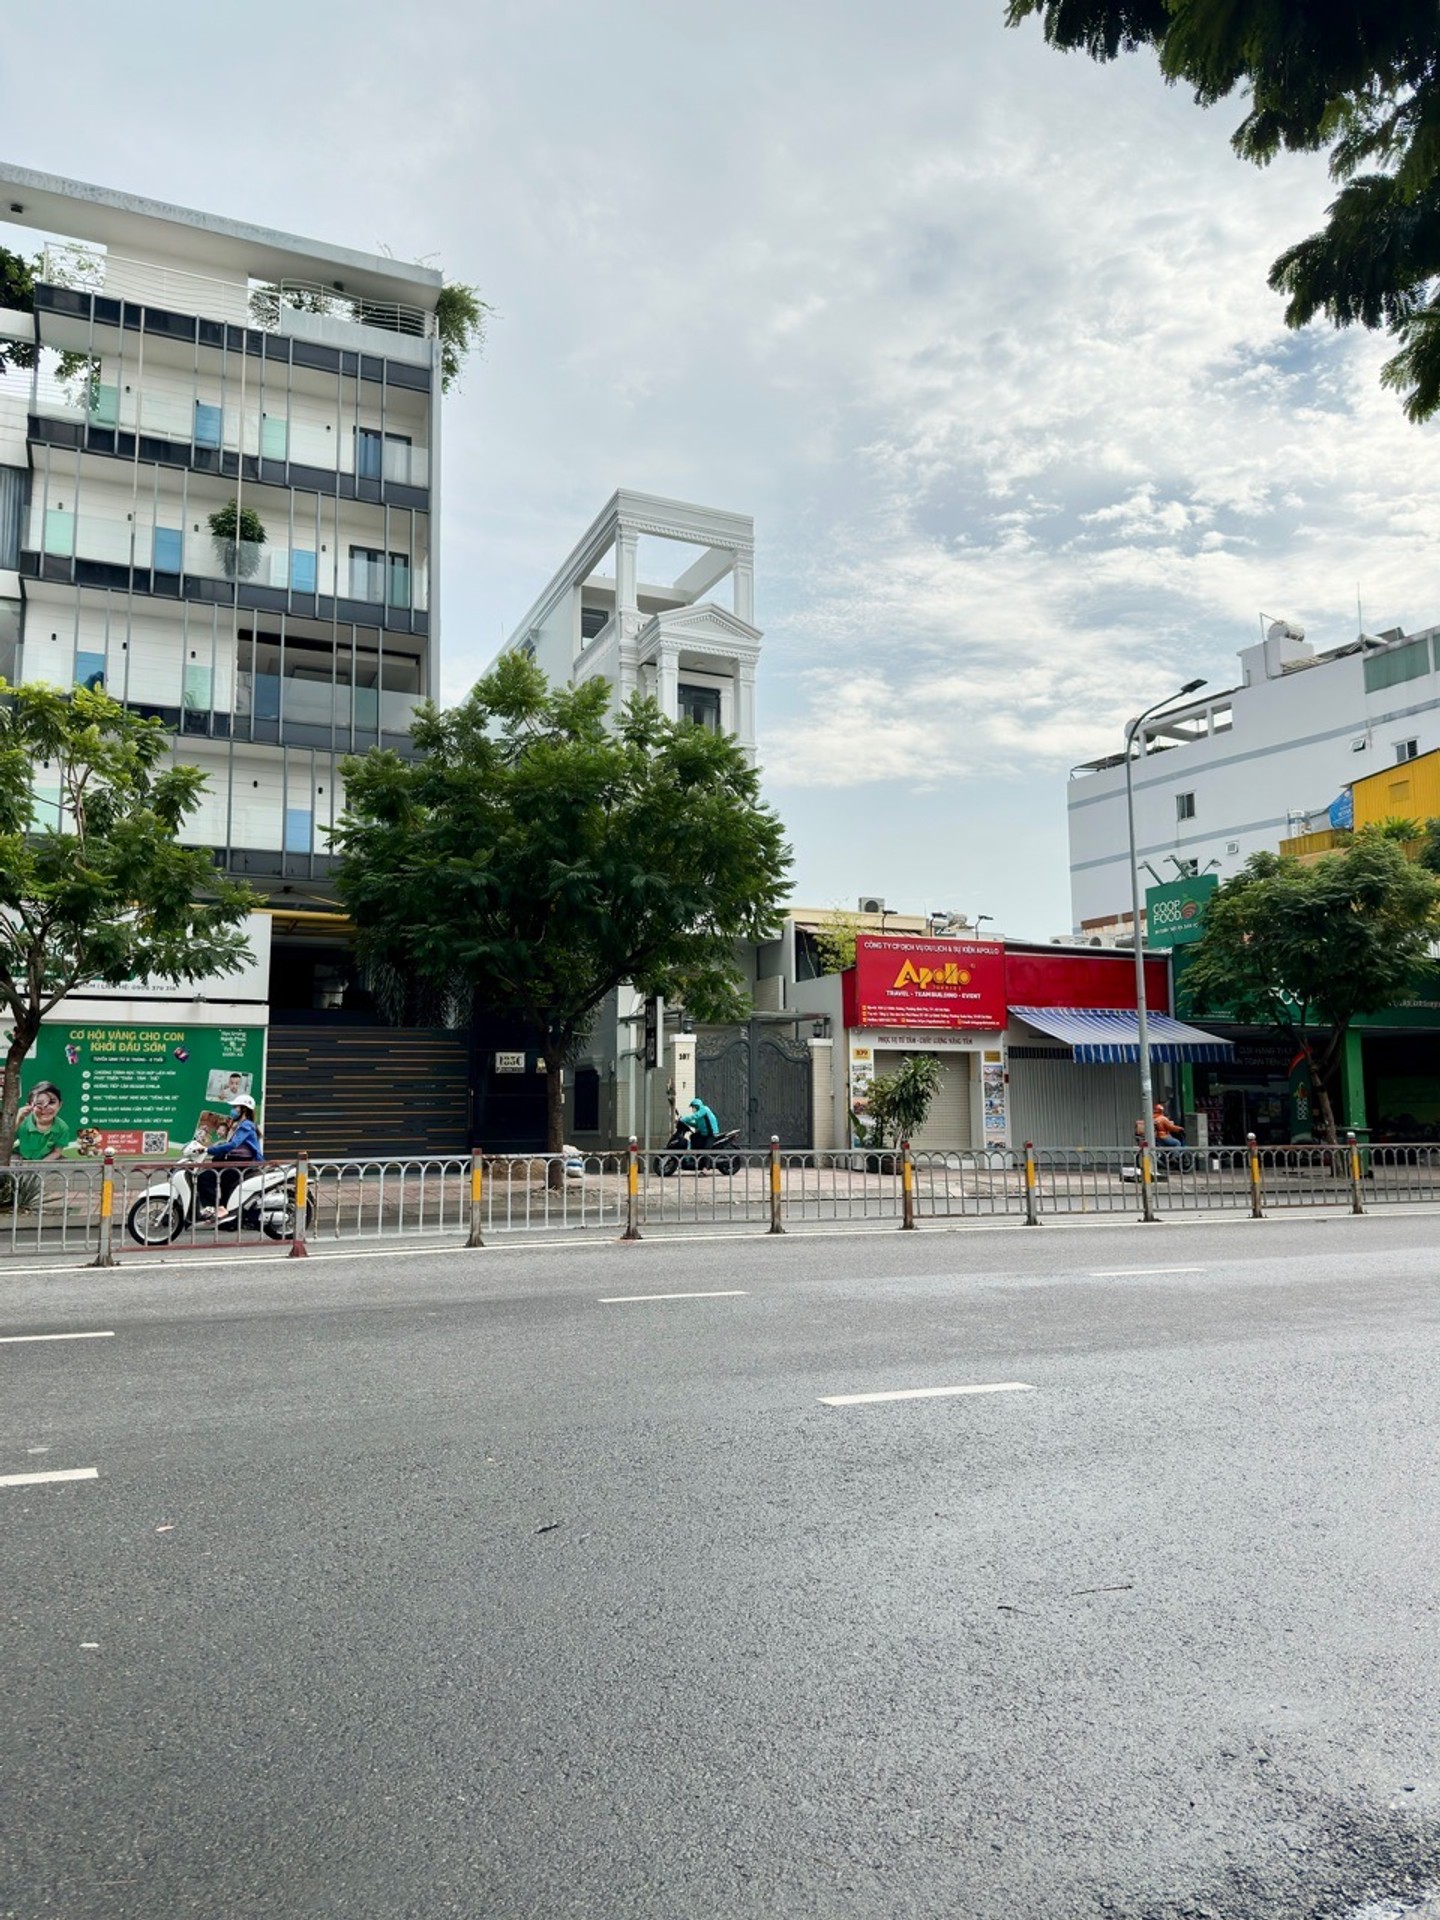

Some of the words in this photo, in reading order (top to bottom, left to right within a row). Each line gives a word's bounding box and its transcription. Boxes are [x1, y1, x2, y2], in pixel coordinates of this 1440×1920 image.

[1153, 899, 1180, 914] COOP
[1153, 910, 1181, 925] FOOD
[893, 958, 972, 990] Apollo
[87, 1028, 105, 1042] HỘI
[108, 1028, 136, 1041] VÀNG
[139, 1031, 160, 1041] CHO
[163, 1032, 185, 1042] CON
[143, 1041, 167, 1053] SỚM
